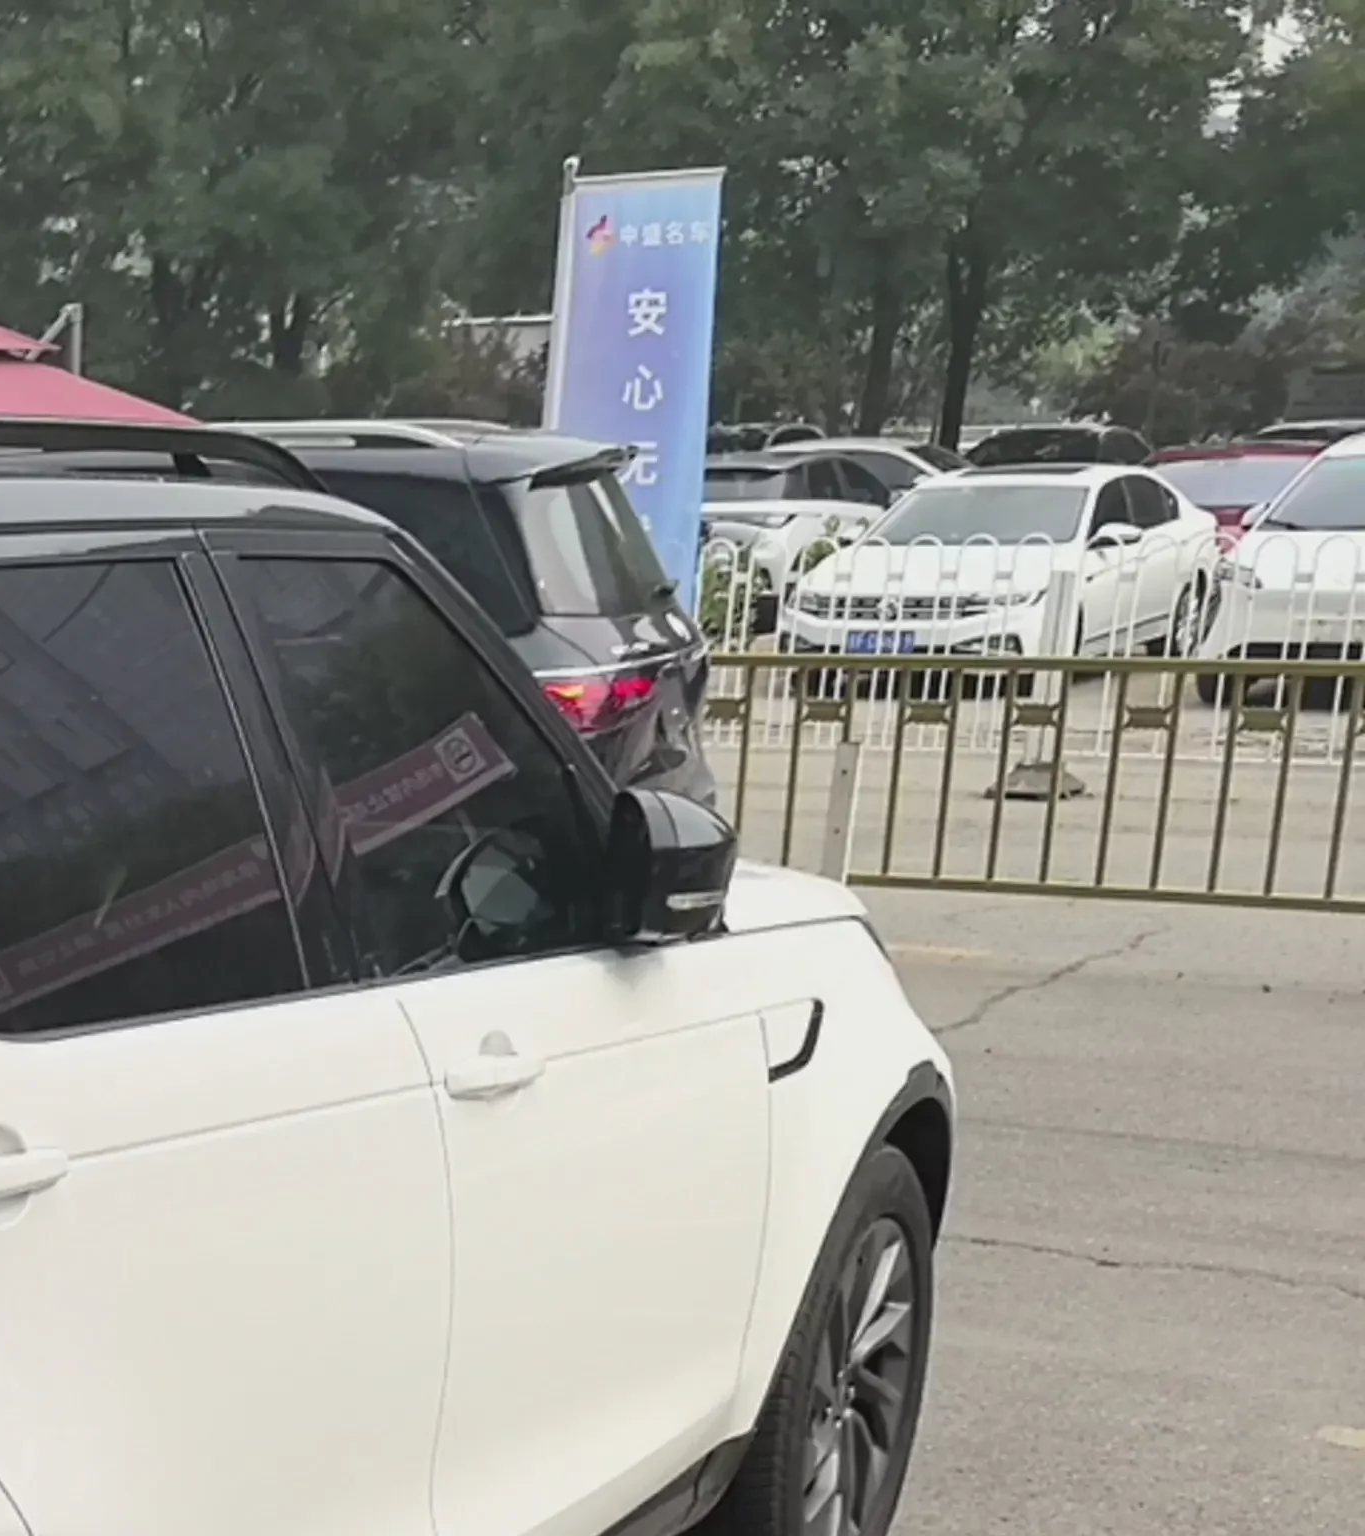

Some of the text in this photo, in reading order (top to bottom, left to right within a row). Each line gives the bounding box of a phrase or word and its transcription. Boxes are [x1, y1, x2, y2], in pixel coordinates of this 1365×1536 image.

[620, 220, 711, 248] 中盛名车
[619, 287, 668, 531] 安心无
